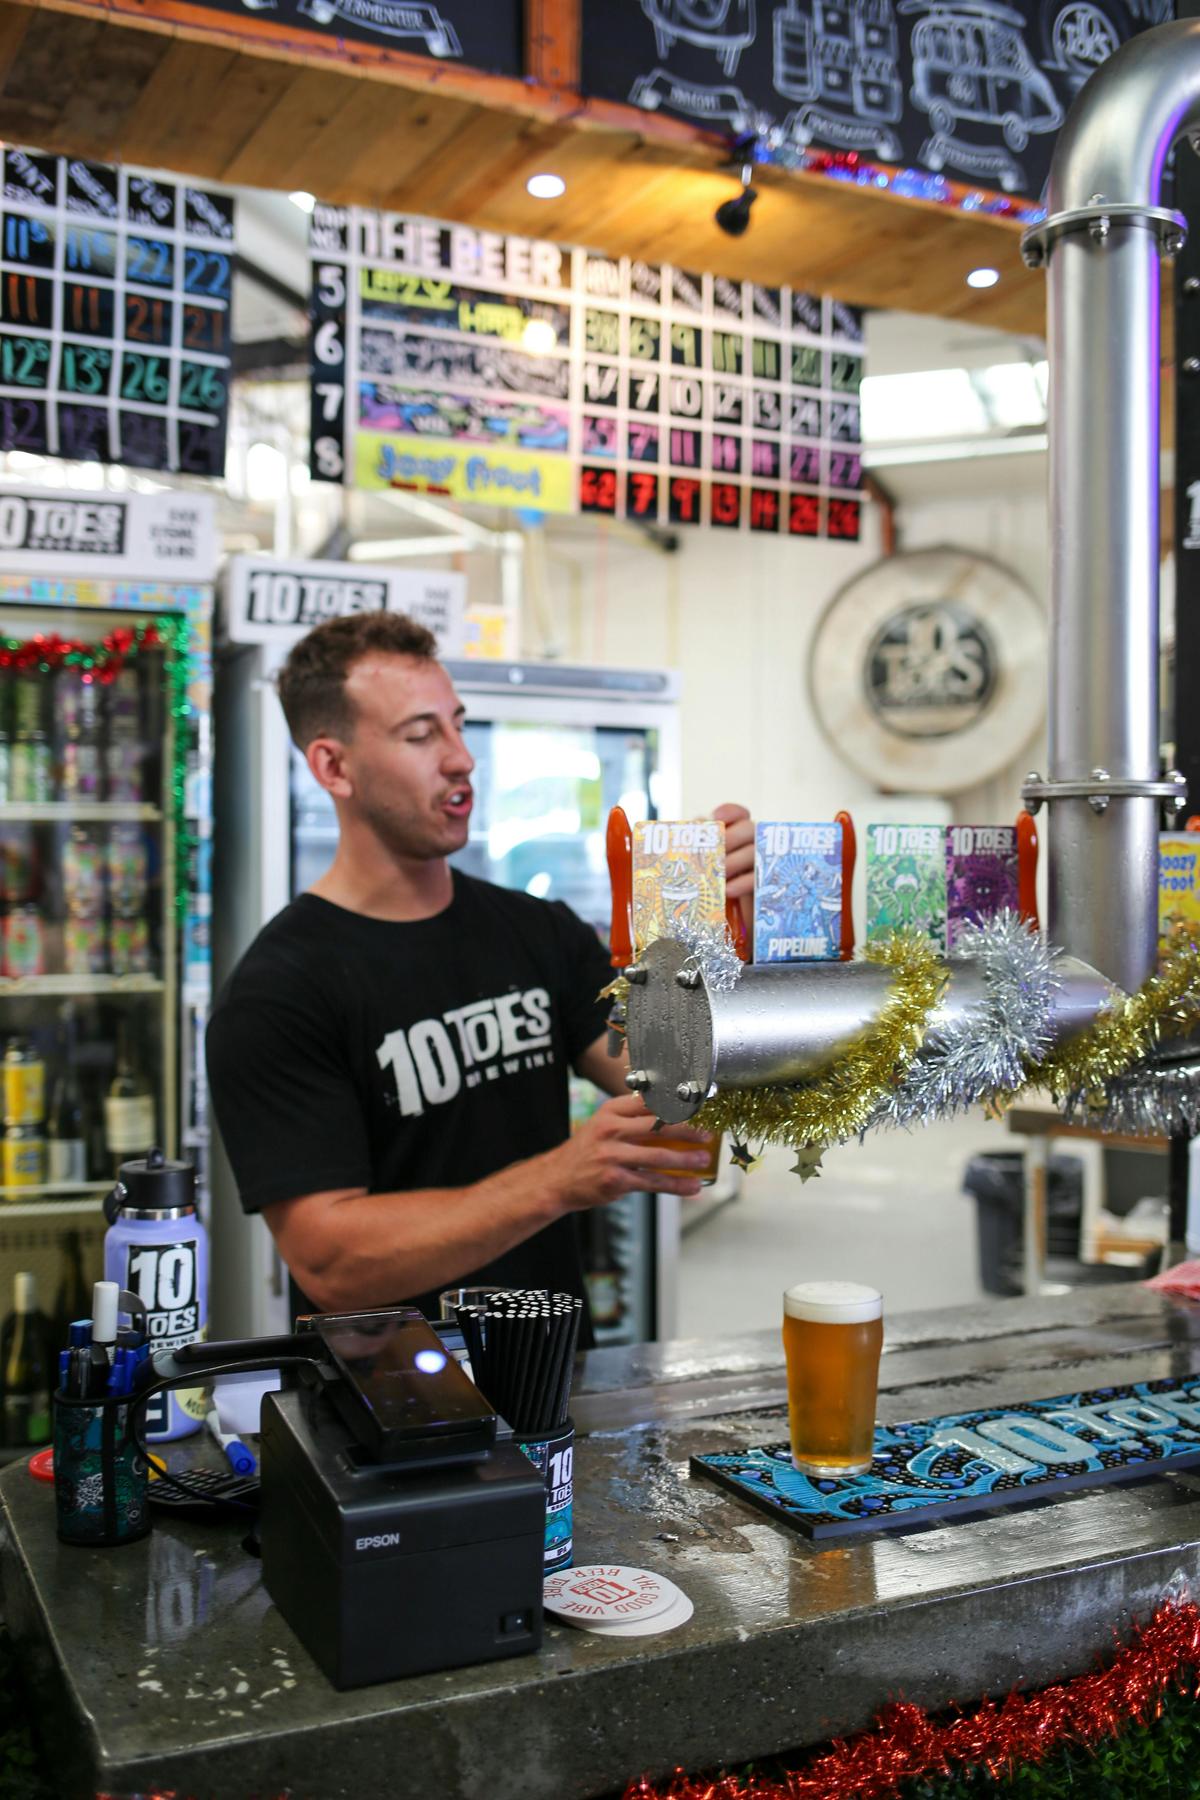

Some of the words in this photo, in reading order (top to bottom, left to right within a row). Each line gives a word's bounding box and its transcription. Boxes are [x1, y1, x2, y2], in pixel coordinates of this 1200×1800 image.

[450, 228, 563, 289] BEER
[318, 266, 345, 307] 5
[314, 321, 343, 365] 6
[124, 354, 169, 401] 26
[316, 383, 344, 421] 7
[314, 436, 343, 477] 8
[0, 496, 26, 548] 0
[30, 502, 122, 544] TOES
[249, 573, 299, 623] 10
[641, 824, 669, 855] 10
[670, 824, 719, 847] TOES
[763, 826, 790, 856] 10
[791, 827, 837, 848] TOES
[873, 826, 898, 856] 10
[899, 828, 941, 848] TOES
[951, 827, 974, 856] 10
[975, 829, 1014, 848] TOES
[768, 936, 829, 957] PIPELINE
[376, 1018, 461, 1117] 10
[443, 987, 551, 1068] TOES
[130, 1247, 195, 1310] 10
[150, 1335, 195, 1348] REWING
[926, 1417, 1098, 1475] 10
[1041, 1387, 1200, 1438] TOE
[549, 1446, 573, 1488] 10
[355, 1533, 400, 1550] EPSON
[632, 1574, 660, 1591] THE
[561, 1600, 605, 1615] VIBE
[614, 1593, 659, 1614] GOOD
